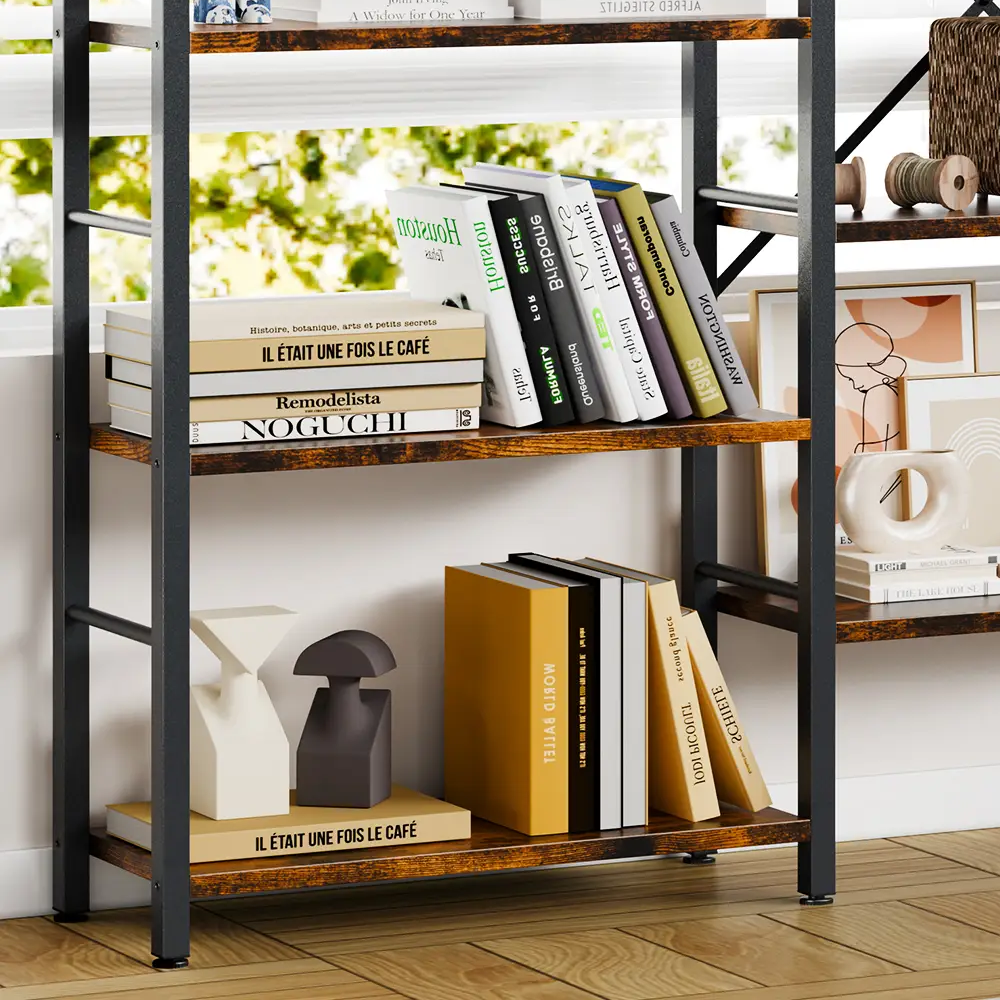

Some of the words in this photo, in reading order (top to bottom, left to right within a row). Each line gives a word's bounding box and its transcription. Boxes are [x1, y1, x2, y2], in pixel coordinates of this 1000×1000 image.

[350, 11, 359, 22] A
[363, 9, 406, 21] Widow
[409, 8, 427, 21] for
[429, 9, 456, 20] One
[459, 8, 486, 20] Year
[250, 326, 290, 335] Histoire,
[292, 323, 340, 333] botanique,
[342, 322, 361, 330] arts
[364, 321, 373, 329] et
[375, 320, 402, 330] petits
[404, 319, 438, 327] secrets
[262, 346, 275, 363] IL
[277, 342, 314, 362] ÉTAIT
[317, 343, 343, 360] UNE
[347, 341, 375, 359] FOIS
[378, 340, 394, 357] LE
[397, 336, 430, 356] CAFÉ
[275, 391, 381, 410] Remodelista
[241, 412, 407, 440] NOGUCHI
[255, 836, 267, 851] IL
[270, 832, 305, 850] ÉTAIT
[308, 830, 333, 847] UNE
[337, 828, 364, 844] FOIS
[367, 825, 383, 842] LE
[385, 820, 417, 840] CAFÉ
